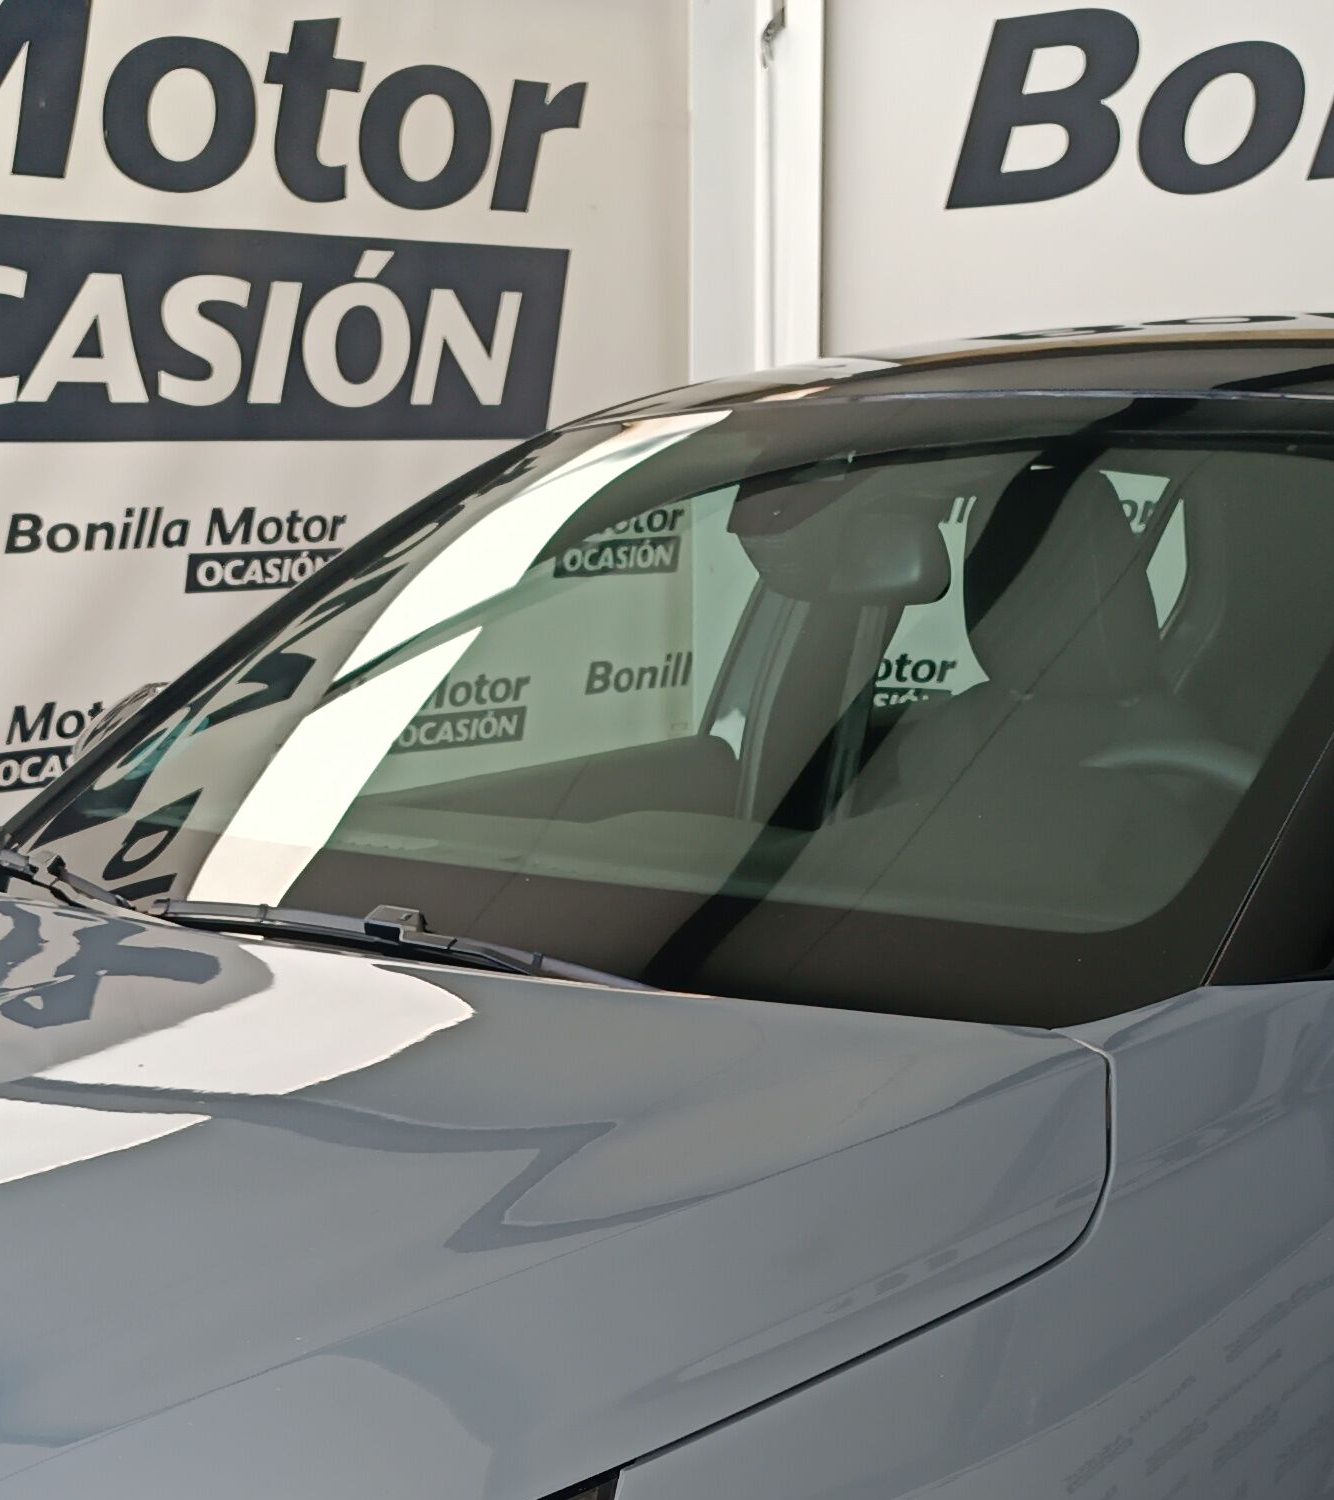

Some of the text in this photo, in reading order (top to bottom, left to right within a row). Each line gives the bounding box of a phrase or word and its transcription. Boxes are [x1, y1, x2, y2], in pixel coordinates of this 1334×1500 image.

[5, 506, 348, 554] Bonilla Motor
[562, 538, 674, 572] OCASIÓN
